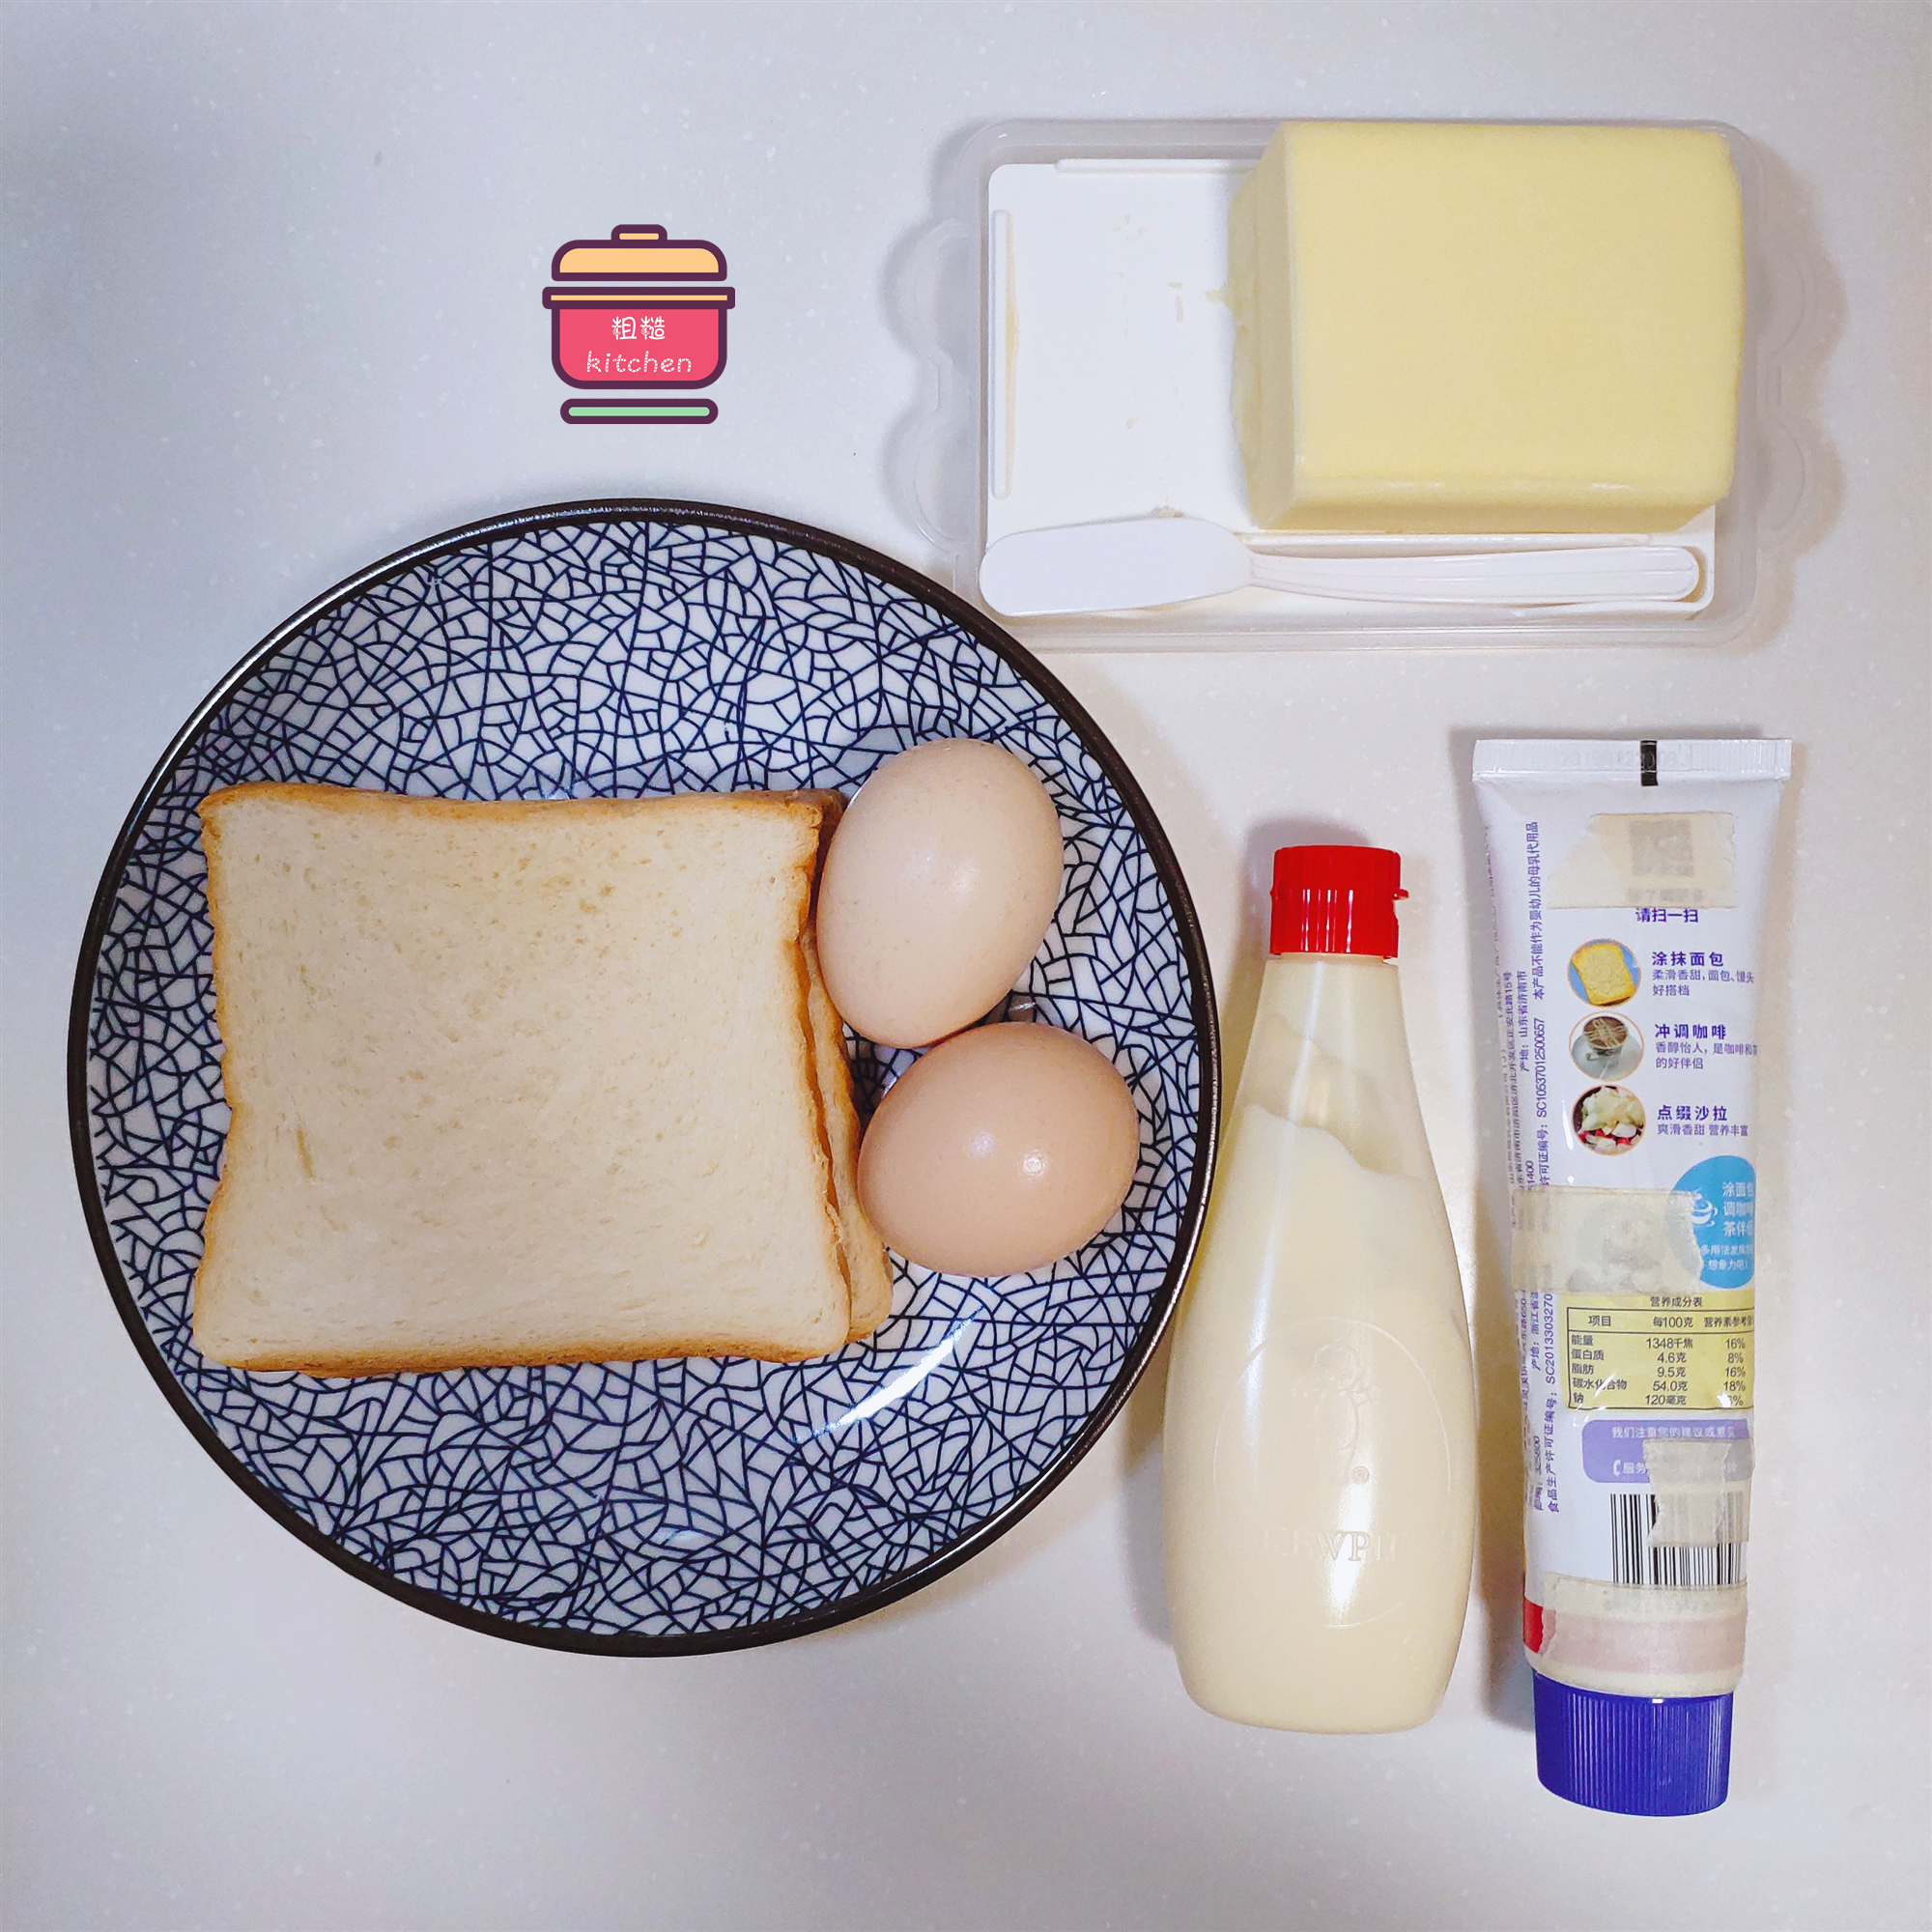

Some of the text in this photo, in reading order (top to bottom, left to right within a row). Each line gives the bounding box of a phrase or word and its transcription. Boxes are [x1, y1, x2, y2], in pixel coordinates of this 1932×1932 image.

[1635, 908, 1698, 923] 请扫一扫
[1652, 952, 1723, 967] 涂抹面包
[1652, 984, 1690, 996] 好搭档
[1655, 1024, 1726, 1039] 冲调咖啡
[1656, 1058, 1704, 1069] 的好伴侣
[1658, 1105, 1727, 1121] 点缀沙拉
[1658, 1123, 1748, 1137] 爽滑香甜 营养丰富
[1650, 1296, 1703, 1308] 营养成分表
[1588, 1316, 1611, 1326] 项目
[1653, 1317, 1693, 1328] 每100克
[1571, 1334, 1746, 1350] 能量 1348千焦 16%
[1571, 1350, 1744, 1364] 蛋白质 4.6克 8%
[1571, 1364, 1746, 1378] 脂肪 9.5克 16%
[1653, 1381, 1688, 1392] 54.0克
[1723, 1380, 1746, 1392] 18%
[1573, 1392, 1584, 1404] 钠
[1644, 1395, 1688, 1406] 120毫克
